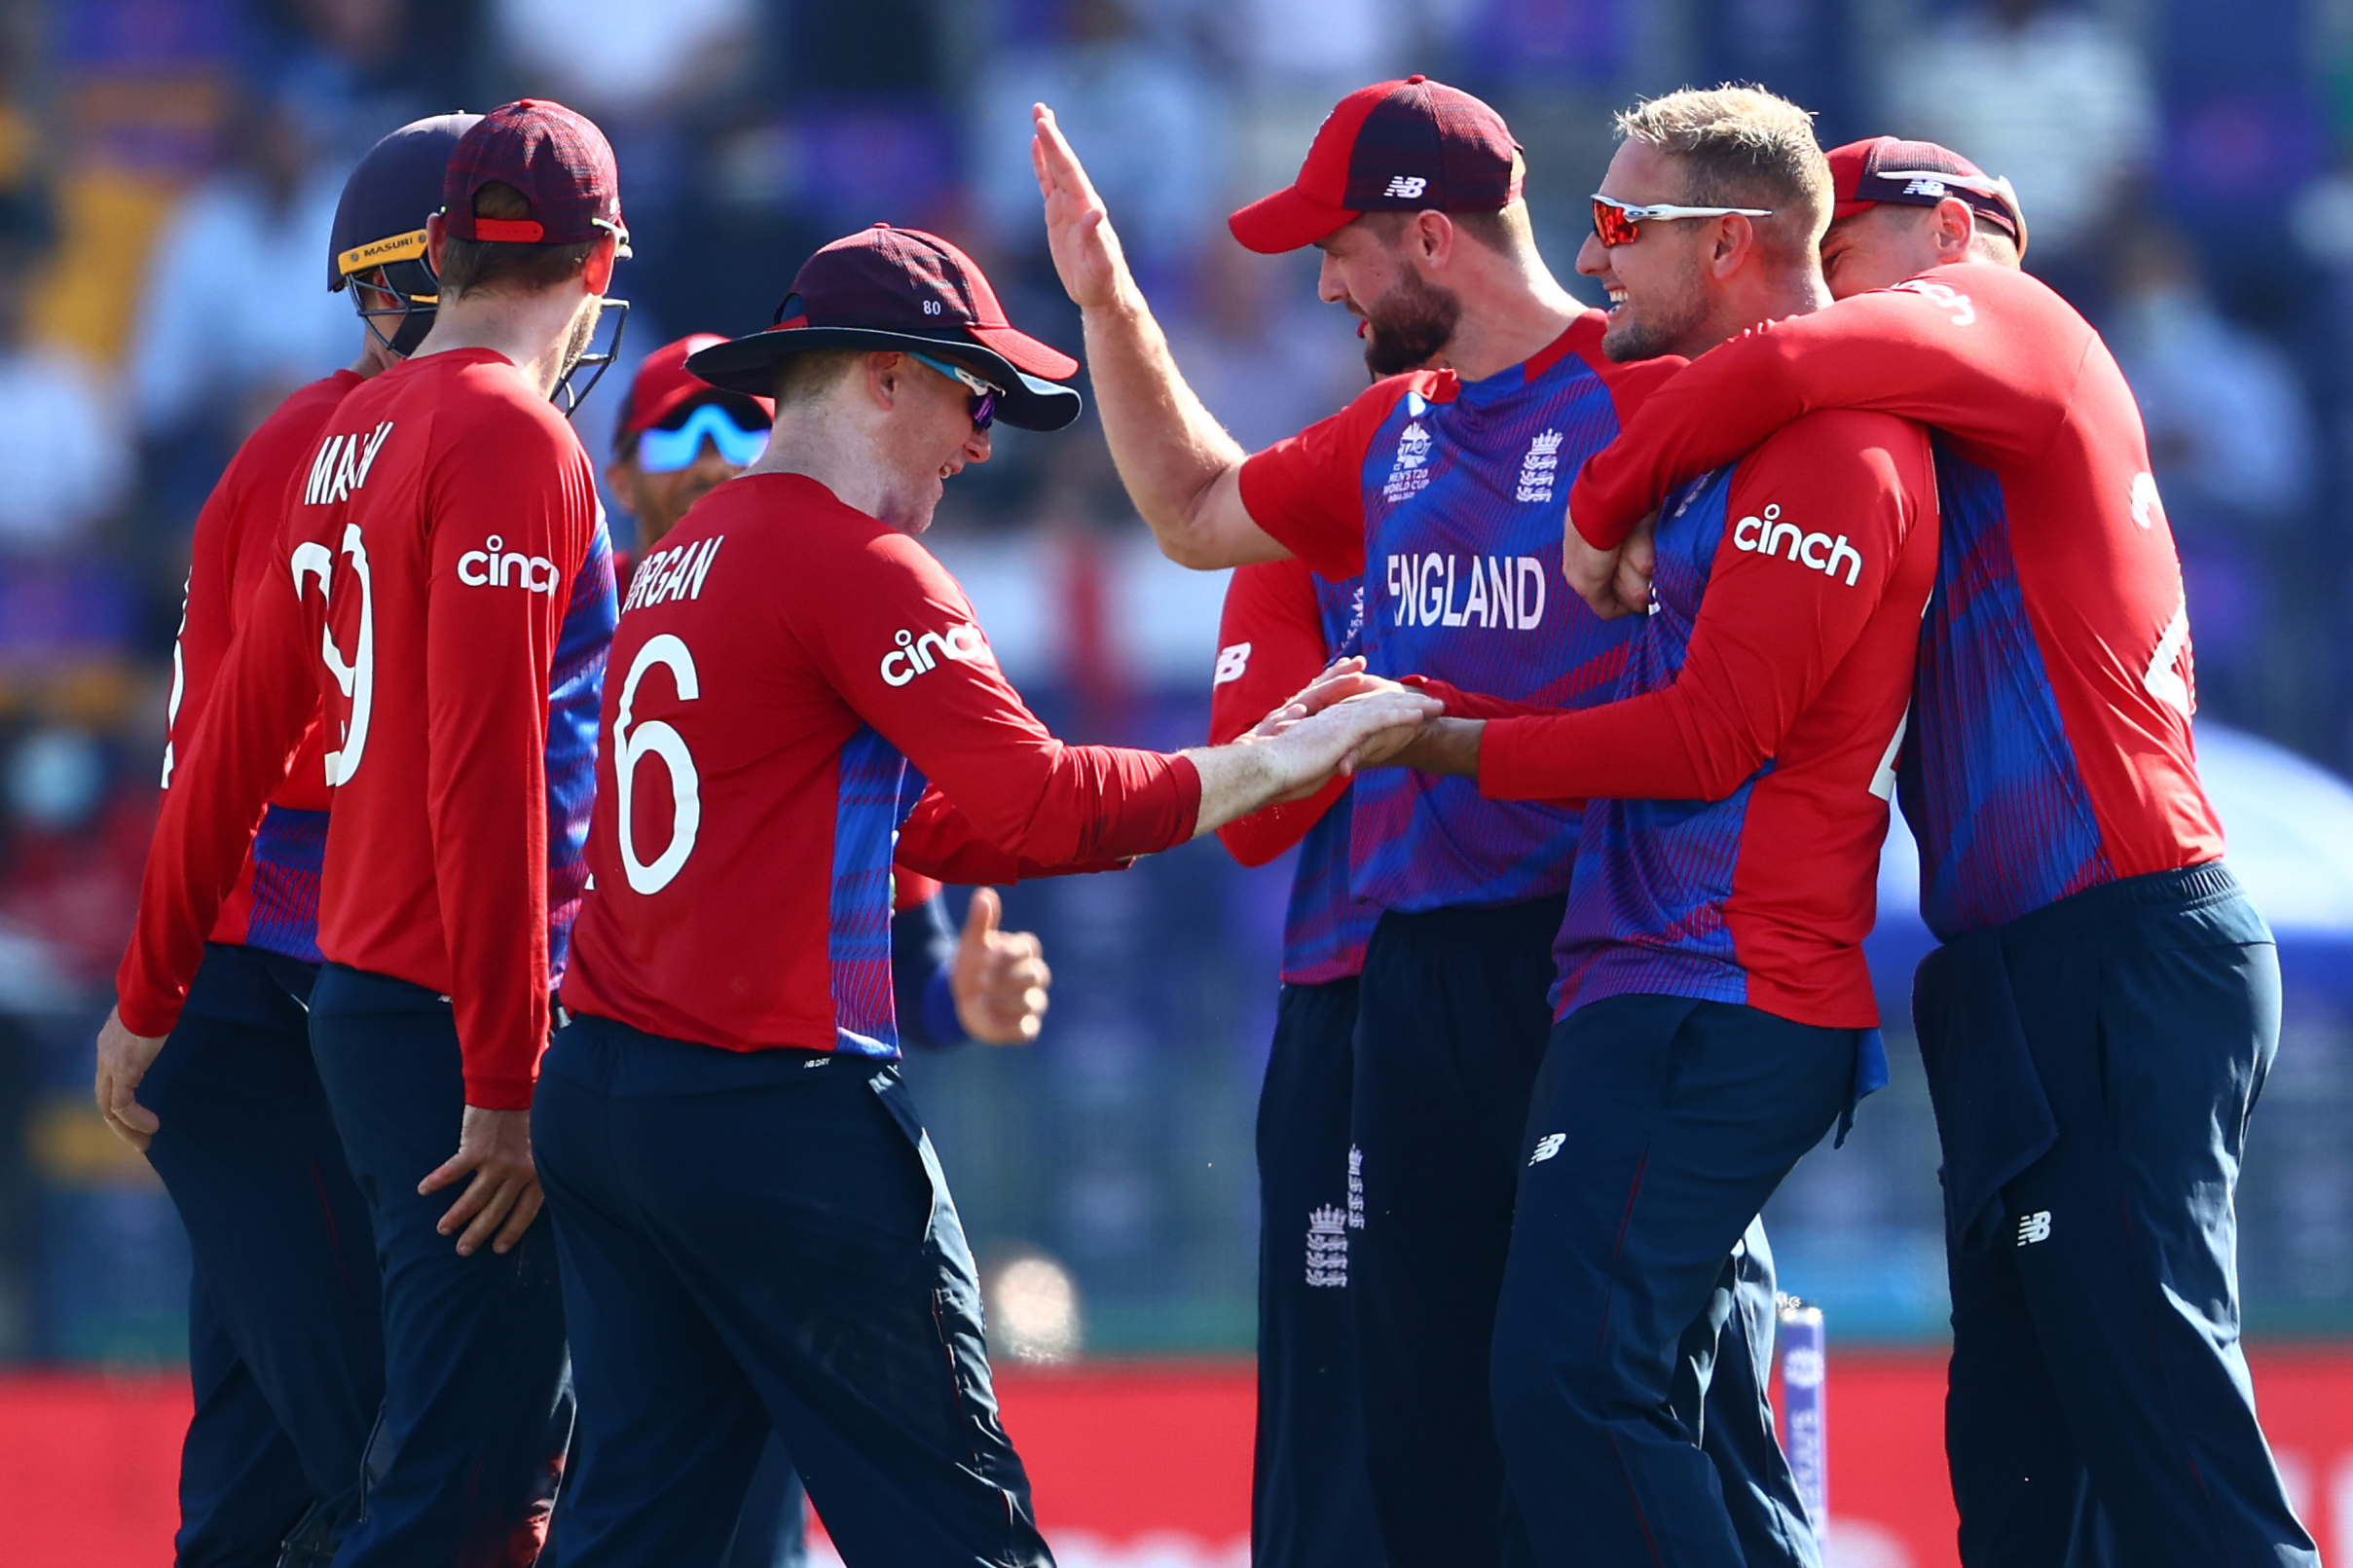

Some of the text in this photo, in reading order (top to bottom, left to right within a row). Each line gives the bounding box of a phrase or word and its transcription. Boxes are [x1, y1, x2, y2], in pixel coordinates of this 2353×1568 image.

[363, 237, 413, 257] MASURI
[923, 300, 941, 315] 80
[1413, 468, 1429, 480] T20
[1382, 479, 1429, 495] WORLD CUP
[1733, 503, 1862, 587] cinch
[1387, 552, 1546, 631] ENGLAND
